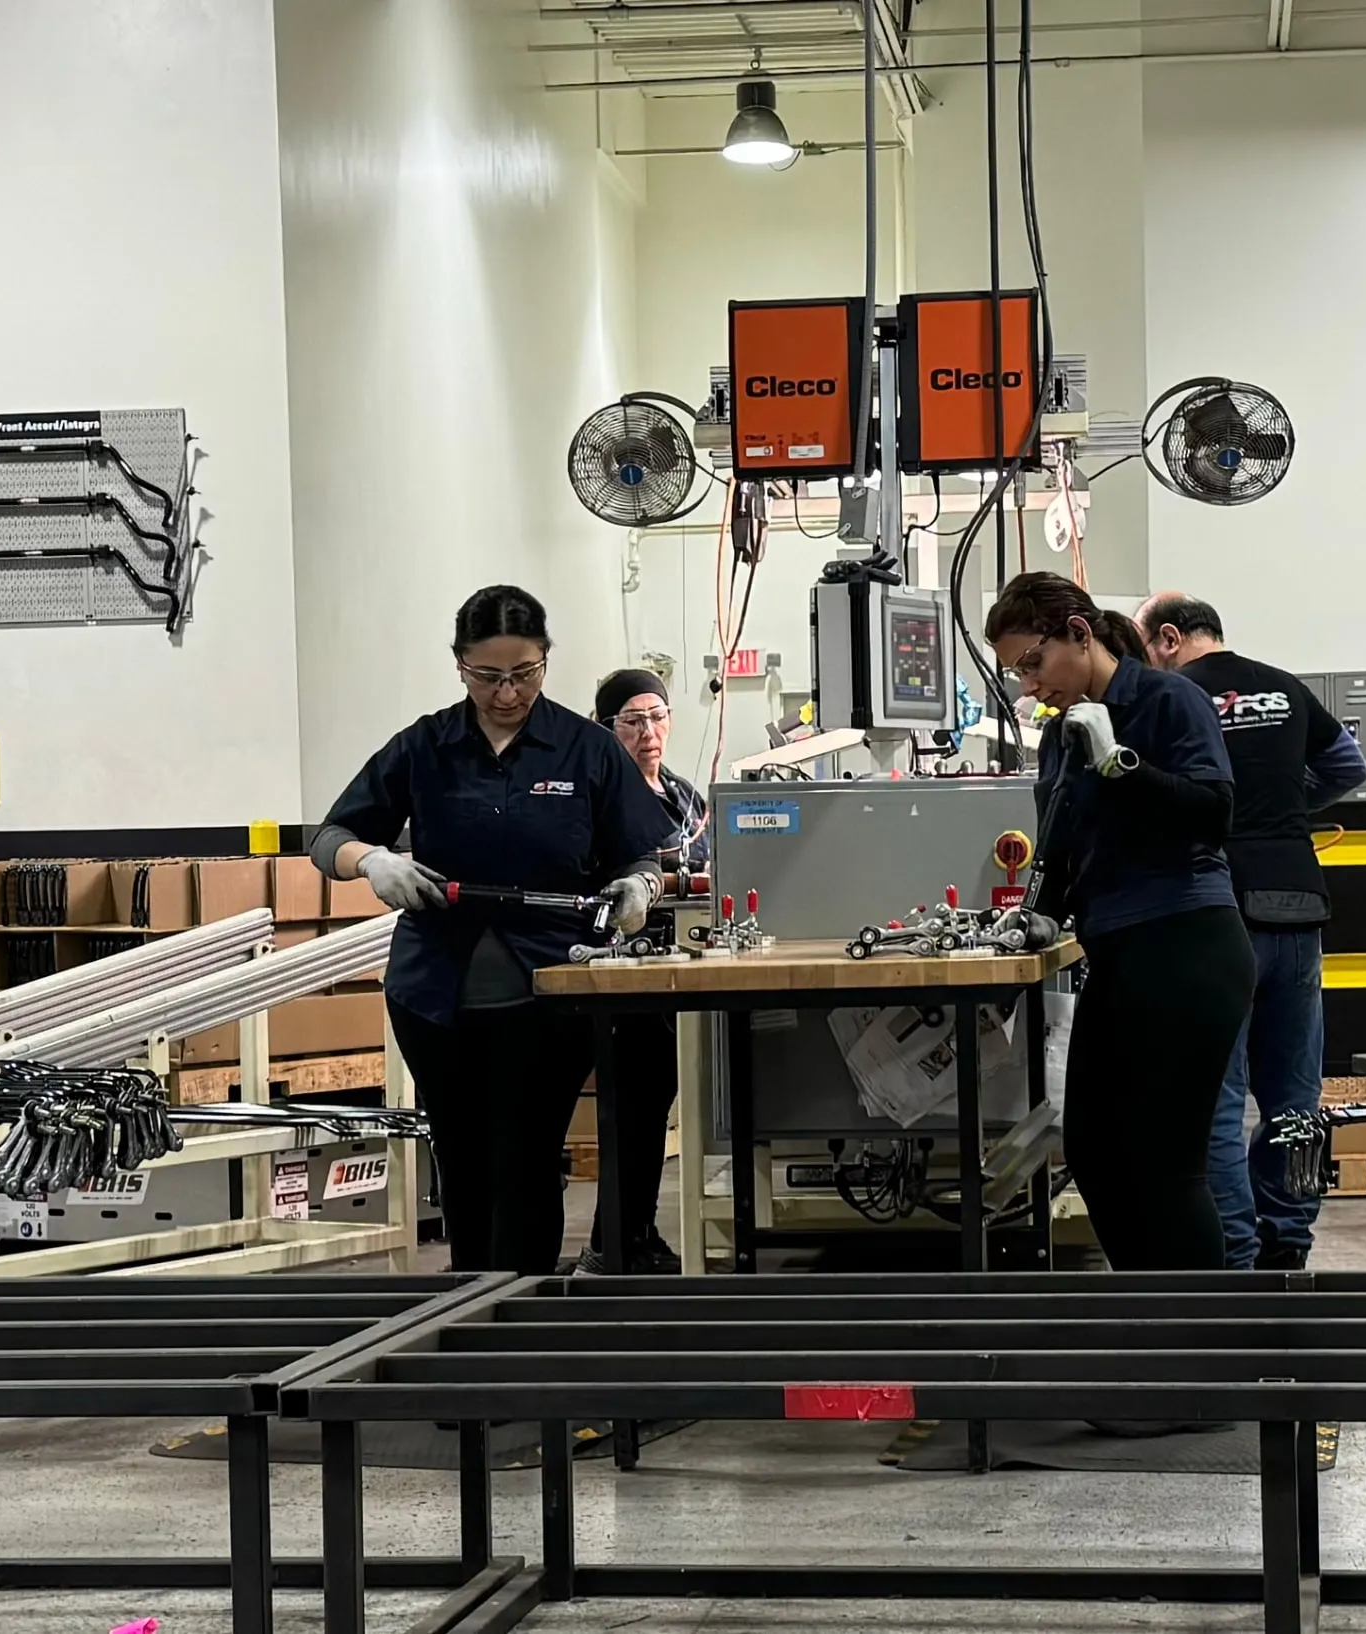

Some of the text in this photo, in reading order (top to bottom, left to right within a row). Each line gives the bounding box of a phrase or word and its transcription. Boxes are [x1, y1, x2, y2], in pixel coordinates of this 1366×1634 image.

[745, 375, 837, 398] Cleco
[930, 367, 1021, 391] Cleco
[24, 419, 100, 431] Accord/Integra
[1001, 895, 1023, 905] DANG
[344, 1159, 387, 1183] BHS
[92, 1174, 143, 1192] BHS
[21, 1210, 40, 1218] VOLTS
